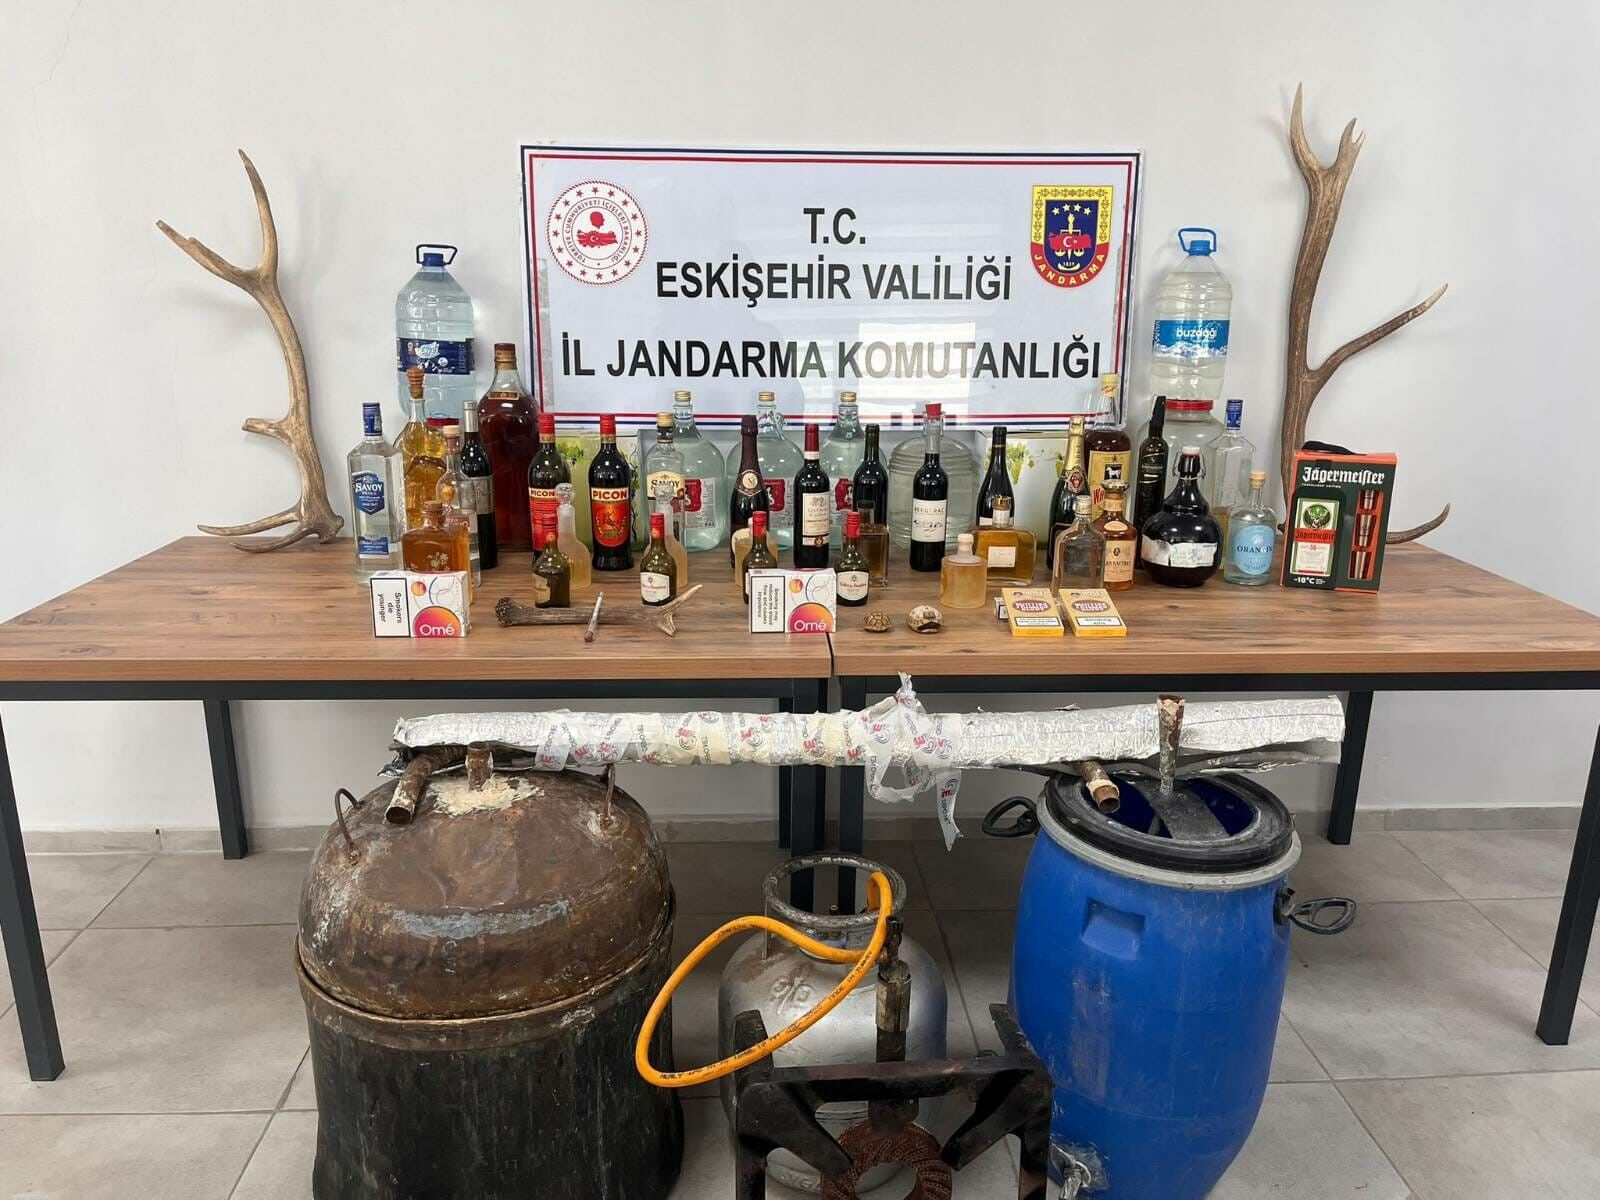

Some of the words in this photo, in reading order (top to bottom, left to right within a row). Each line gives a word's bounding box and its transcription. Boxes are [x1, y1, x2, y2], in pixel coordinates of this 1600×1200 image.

[803, 207, 867, 245] T.C.
[656, 253, 852, 308] ESKİŞEHİR
[862, 255, 1012, 301] VALİLİĞİ
[1034, 253, 1106, 285] JANDARMA
[562, 331, 596, 376] İL
[607, 339, 828, 378] JANDARMA
[838, 334, 1100, 379] KOMUTANLIĞI
[355, 482, 383, 492] SAVOY
[1302, 466, 1385, 486] Jägermeister
[592, 490, 628, 500] PICON
[377, 593, 386, 623] younger
[394, 592, 402, 624] Smokers
[419, 623, 455, 636] Omé
[793, 618, 827, 632] Omé
